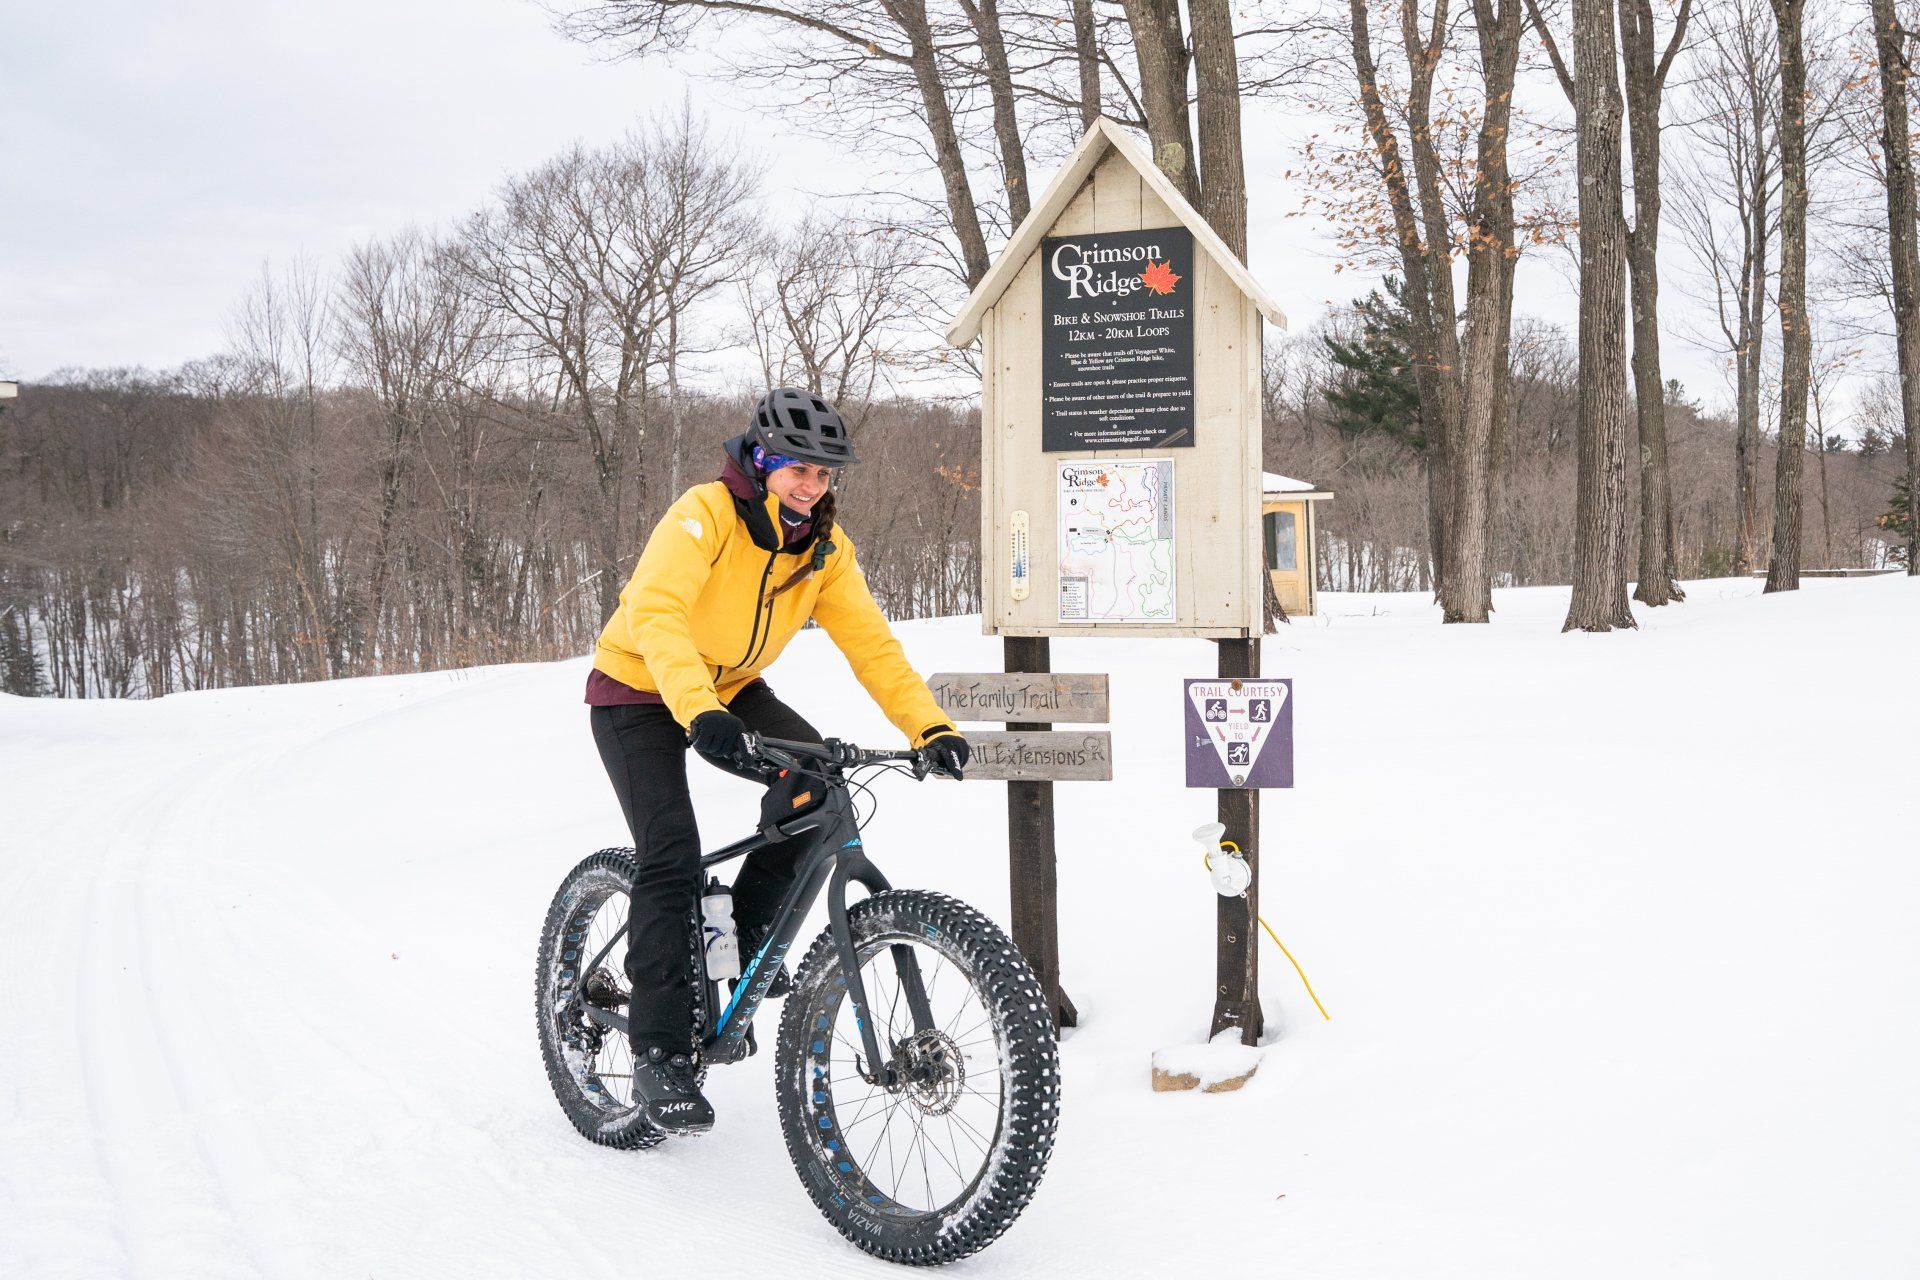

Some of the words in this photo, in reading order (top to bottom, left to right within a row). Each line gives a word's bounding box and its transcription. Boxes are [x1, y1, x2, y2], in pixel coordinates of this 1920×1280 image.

[1052, 243, 1162, 281] Crimson
[1066, 264, 1142, 299] Ridge
[1081, 312, 1091, 324] &
[1127, 377, 1147, 385] practice
[1152, 391, 1171, 399] prepare
[1062, 467, 1103, 481] Crimson
[1068, 475, 1096, 488] Ridge
[1194, 686, 1224, 697] TRAIL
[1228, 686, 1283, 697] COURTESY
[935, 683, 968, 709] The
[970, 682, 1015, 714] Family
[1019, 684, 1060, 709] Trail
[1228, 722, 1249, 730] YIELD
[1234, 732, 1244, 740] TO
[667, 1102, 696, 1114] LAKE
[847, 1208, 883, 1236] WAZIA
